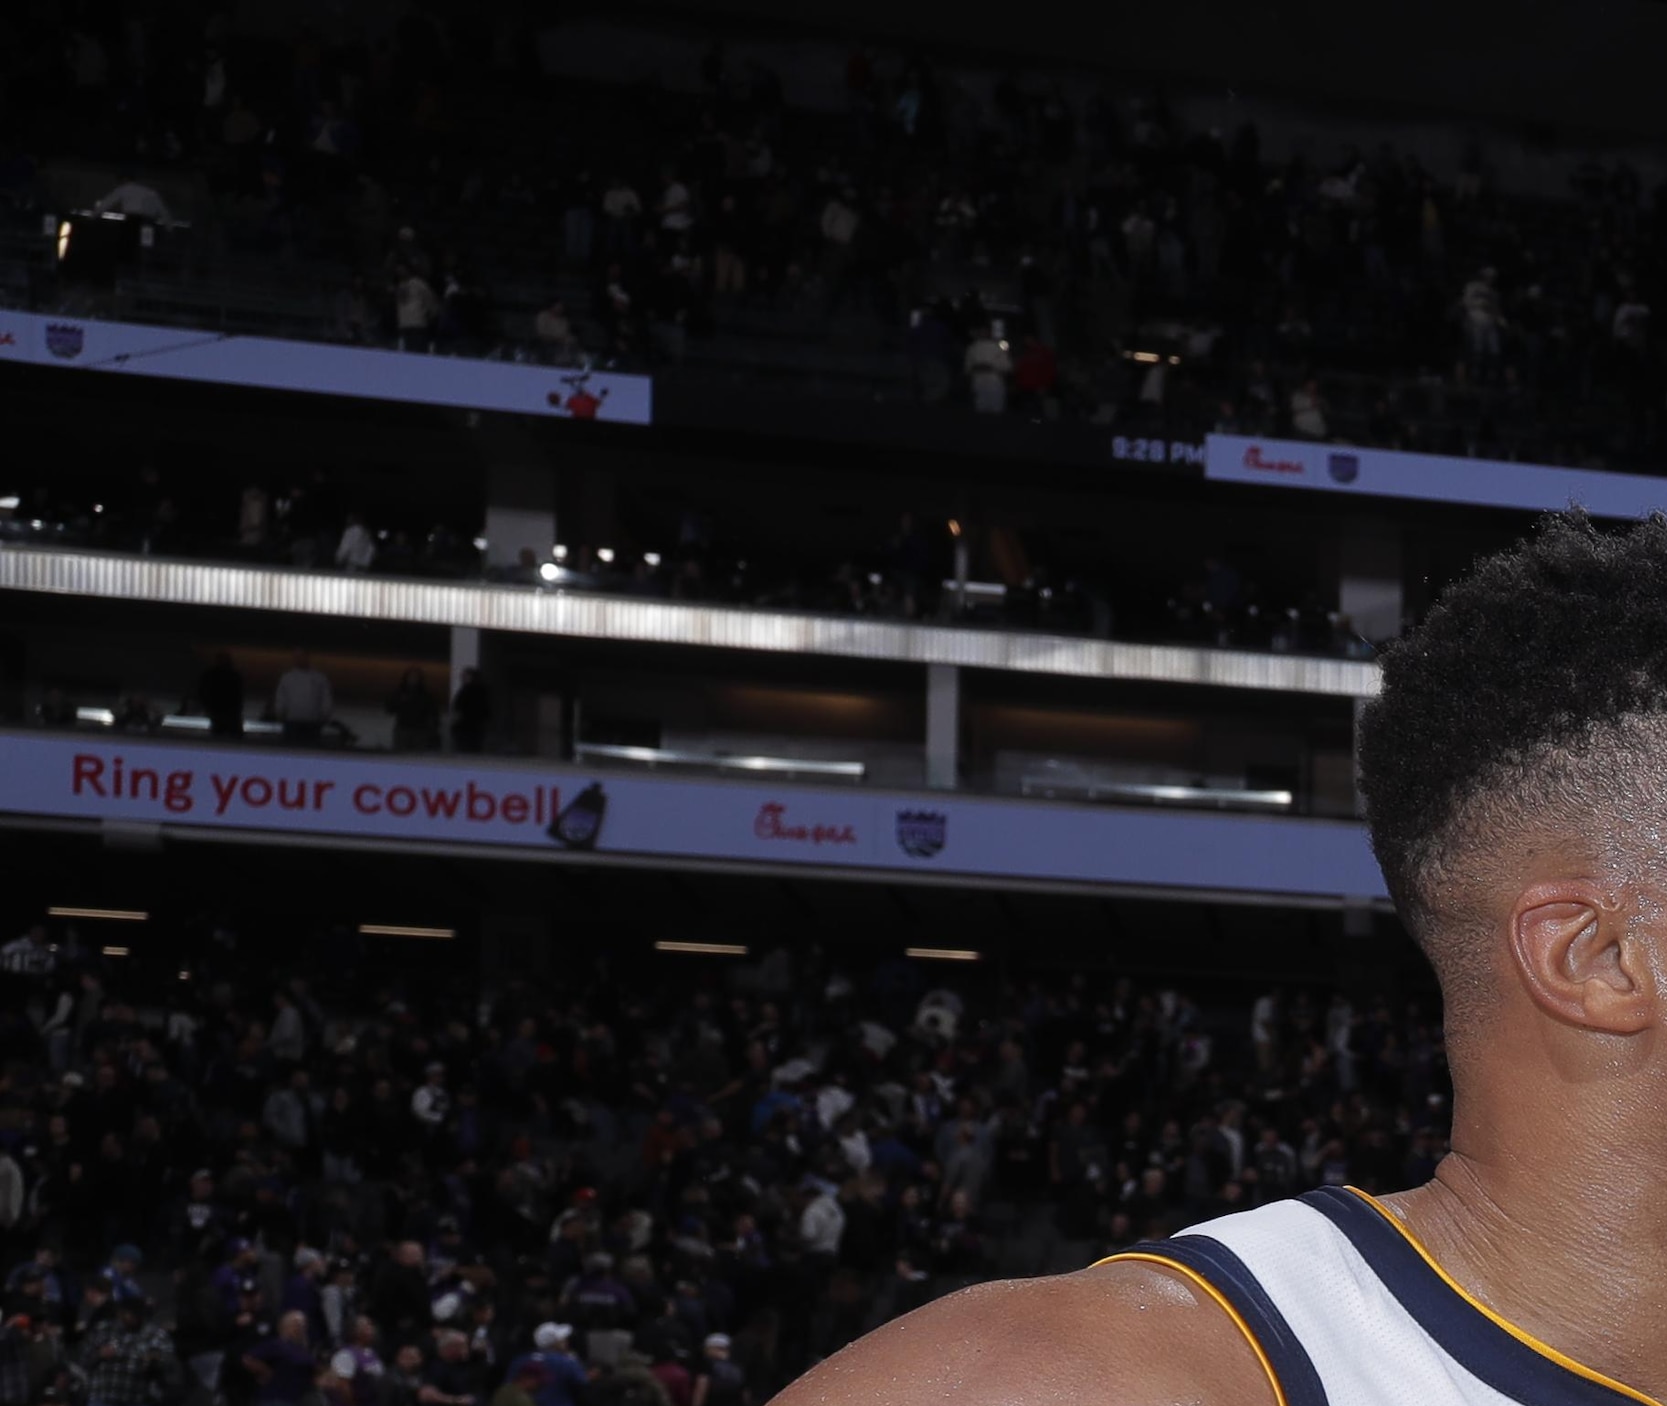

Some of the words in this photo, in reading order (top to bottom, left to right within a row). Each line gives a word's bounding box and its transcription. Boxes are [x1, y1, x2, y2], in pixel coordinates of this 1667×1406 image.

[72, 754, 193, 812] Ring
[211, 774, 334, 815] your
[353, 782, 561, 825] cowbell
